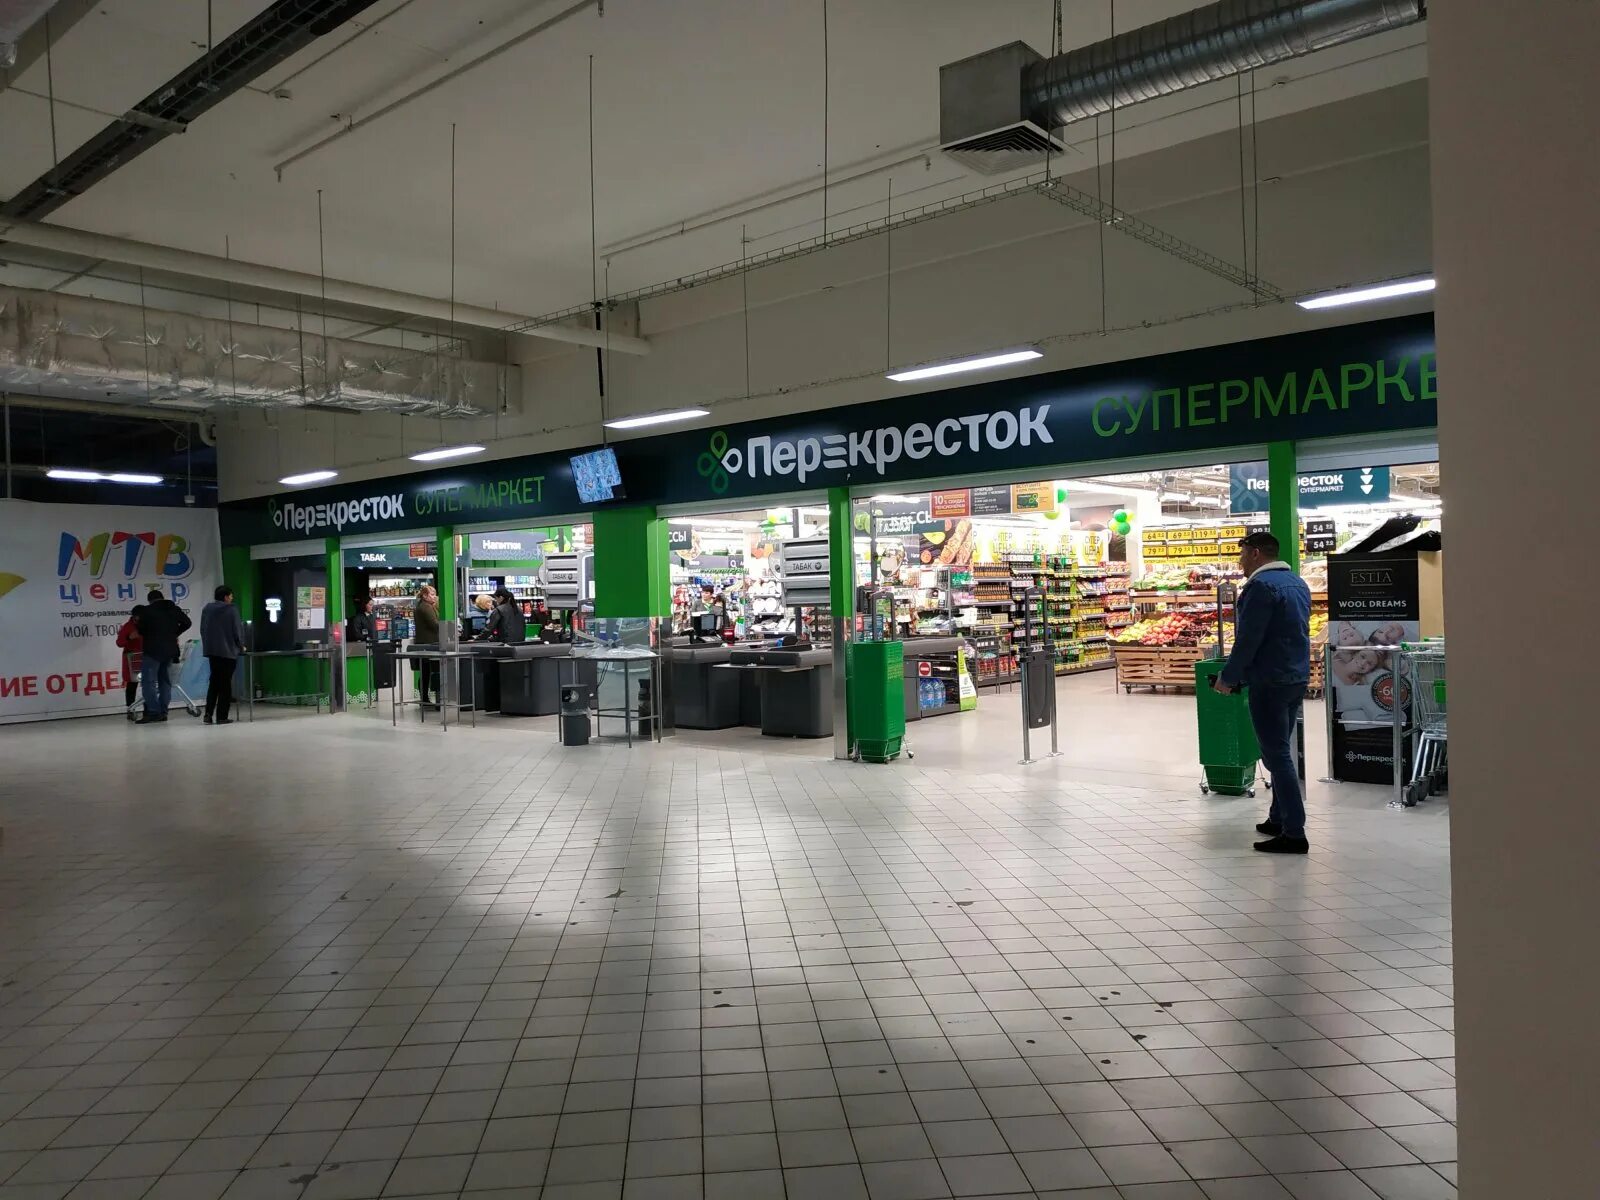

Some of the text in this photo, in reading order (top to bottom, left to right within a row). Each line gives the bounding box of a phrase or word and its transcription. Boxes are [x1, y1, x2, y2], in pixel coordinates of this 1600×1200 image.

[747, 405, 1054, 483] Перекресток
[1247, 474, 1344, 491] Пересток
[284, 476, 545, 535] Перекресток СУПЕРМАРКЕТ
[933, 495, 944, 505] 10
[1312, 524, 1323, 533] 54
[482, 540, 522, 550] Напитки
[1313, 540, 1324, 549] 54
[57, 531, 193, 579] МТВ
[360, 553, 387, 562] ТАБАК
[1350, 571, 1392, 584] ESTIA
[59, 582, 189, 605] центр
[1338, 600, 1407, 608] WOOL DREAMS
